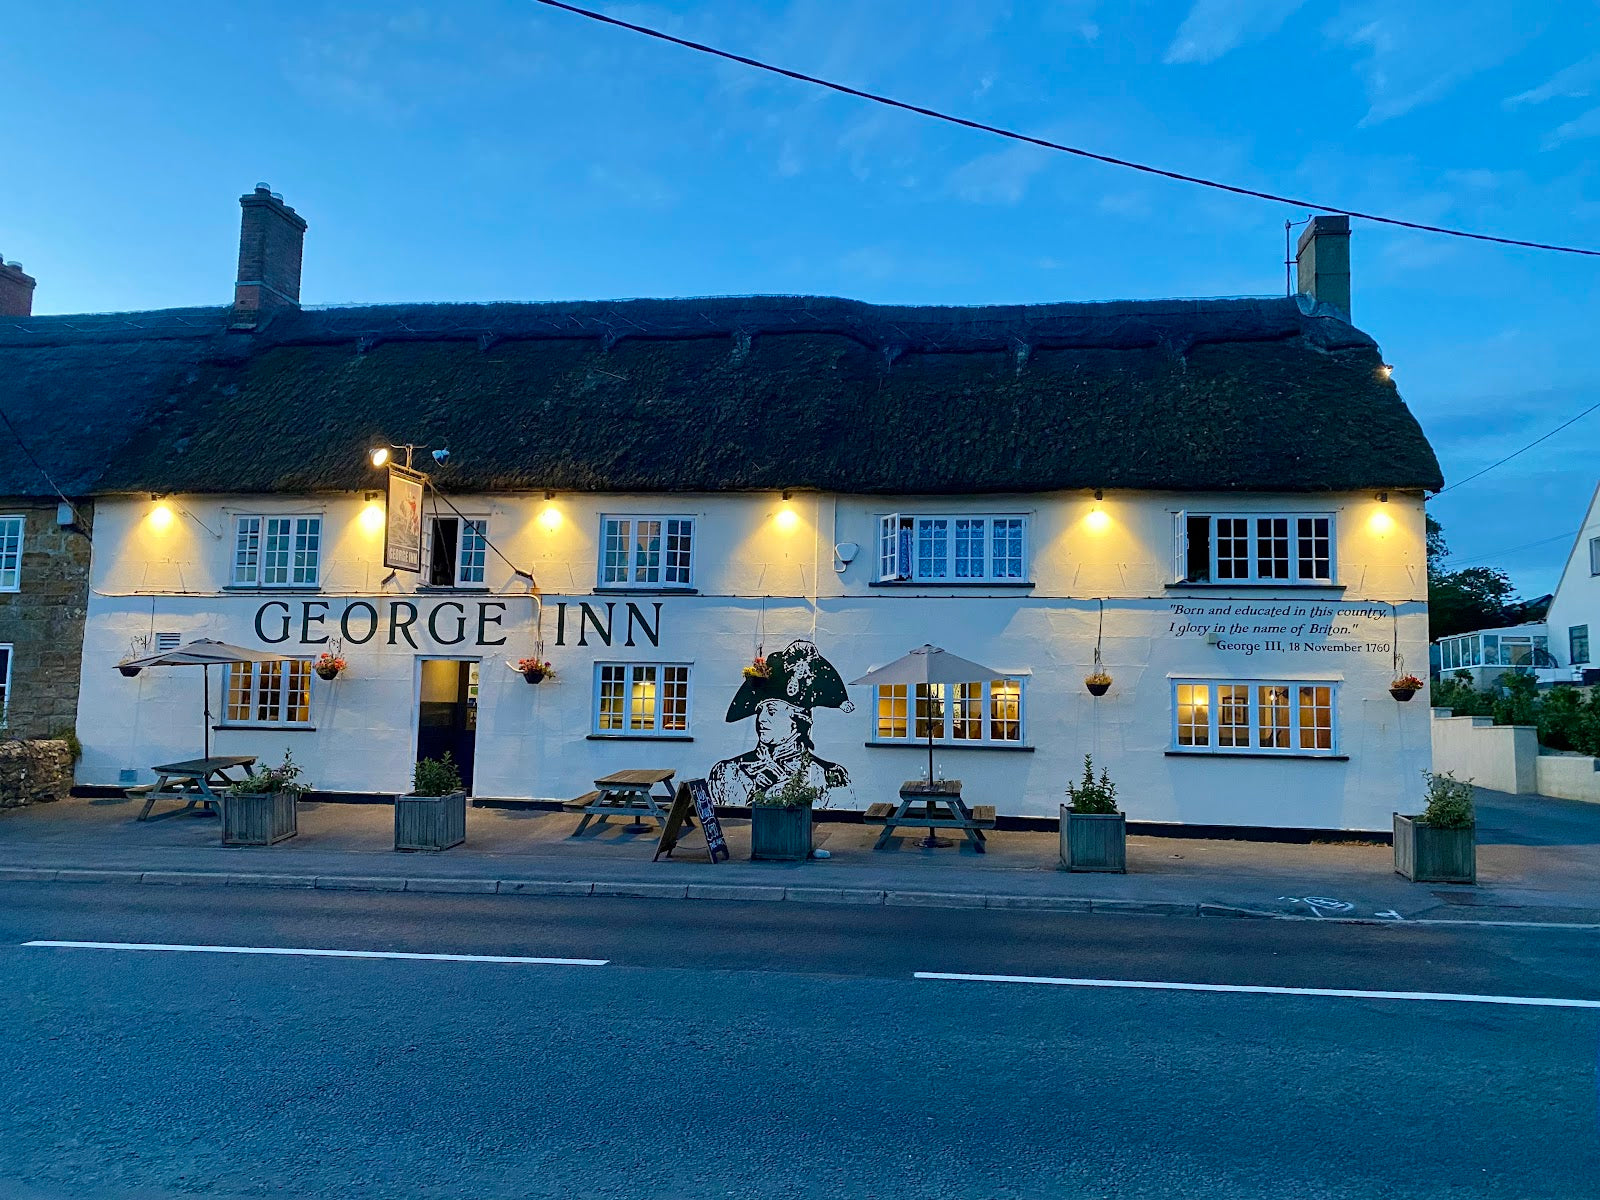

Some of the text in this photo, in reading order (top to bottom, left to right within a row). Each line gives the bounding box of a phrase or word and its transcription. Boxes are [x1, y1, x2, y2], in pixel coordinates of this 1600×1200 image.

[1208, 605, 1232, 615] and
[1234, 605, 1291, 618] educated
[1293, 606, 1306, 616] in
[1310, 606, 1333, 618] this
[1337, 607, 1387, 620] country,
[254, 601, 664, 649] GEORGE INN
[1169, 622, 1175, 632] I
[1175, 622, 1211, 637] glory
[1213, 622, 1226, 633] in
[1229, 622, 1249, 635] the
[1253, 625, 1287, 634] name
[1290, 624, 1306, 637] of
[1216, 640, 1390, 656] George III, 18 November 1760
